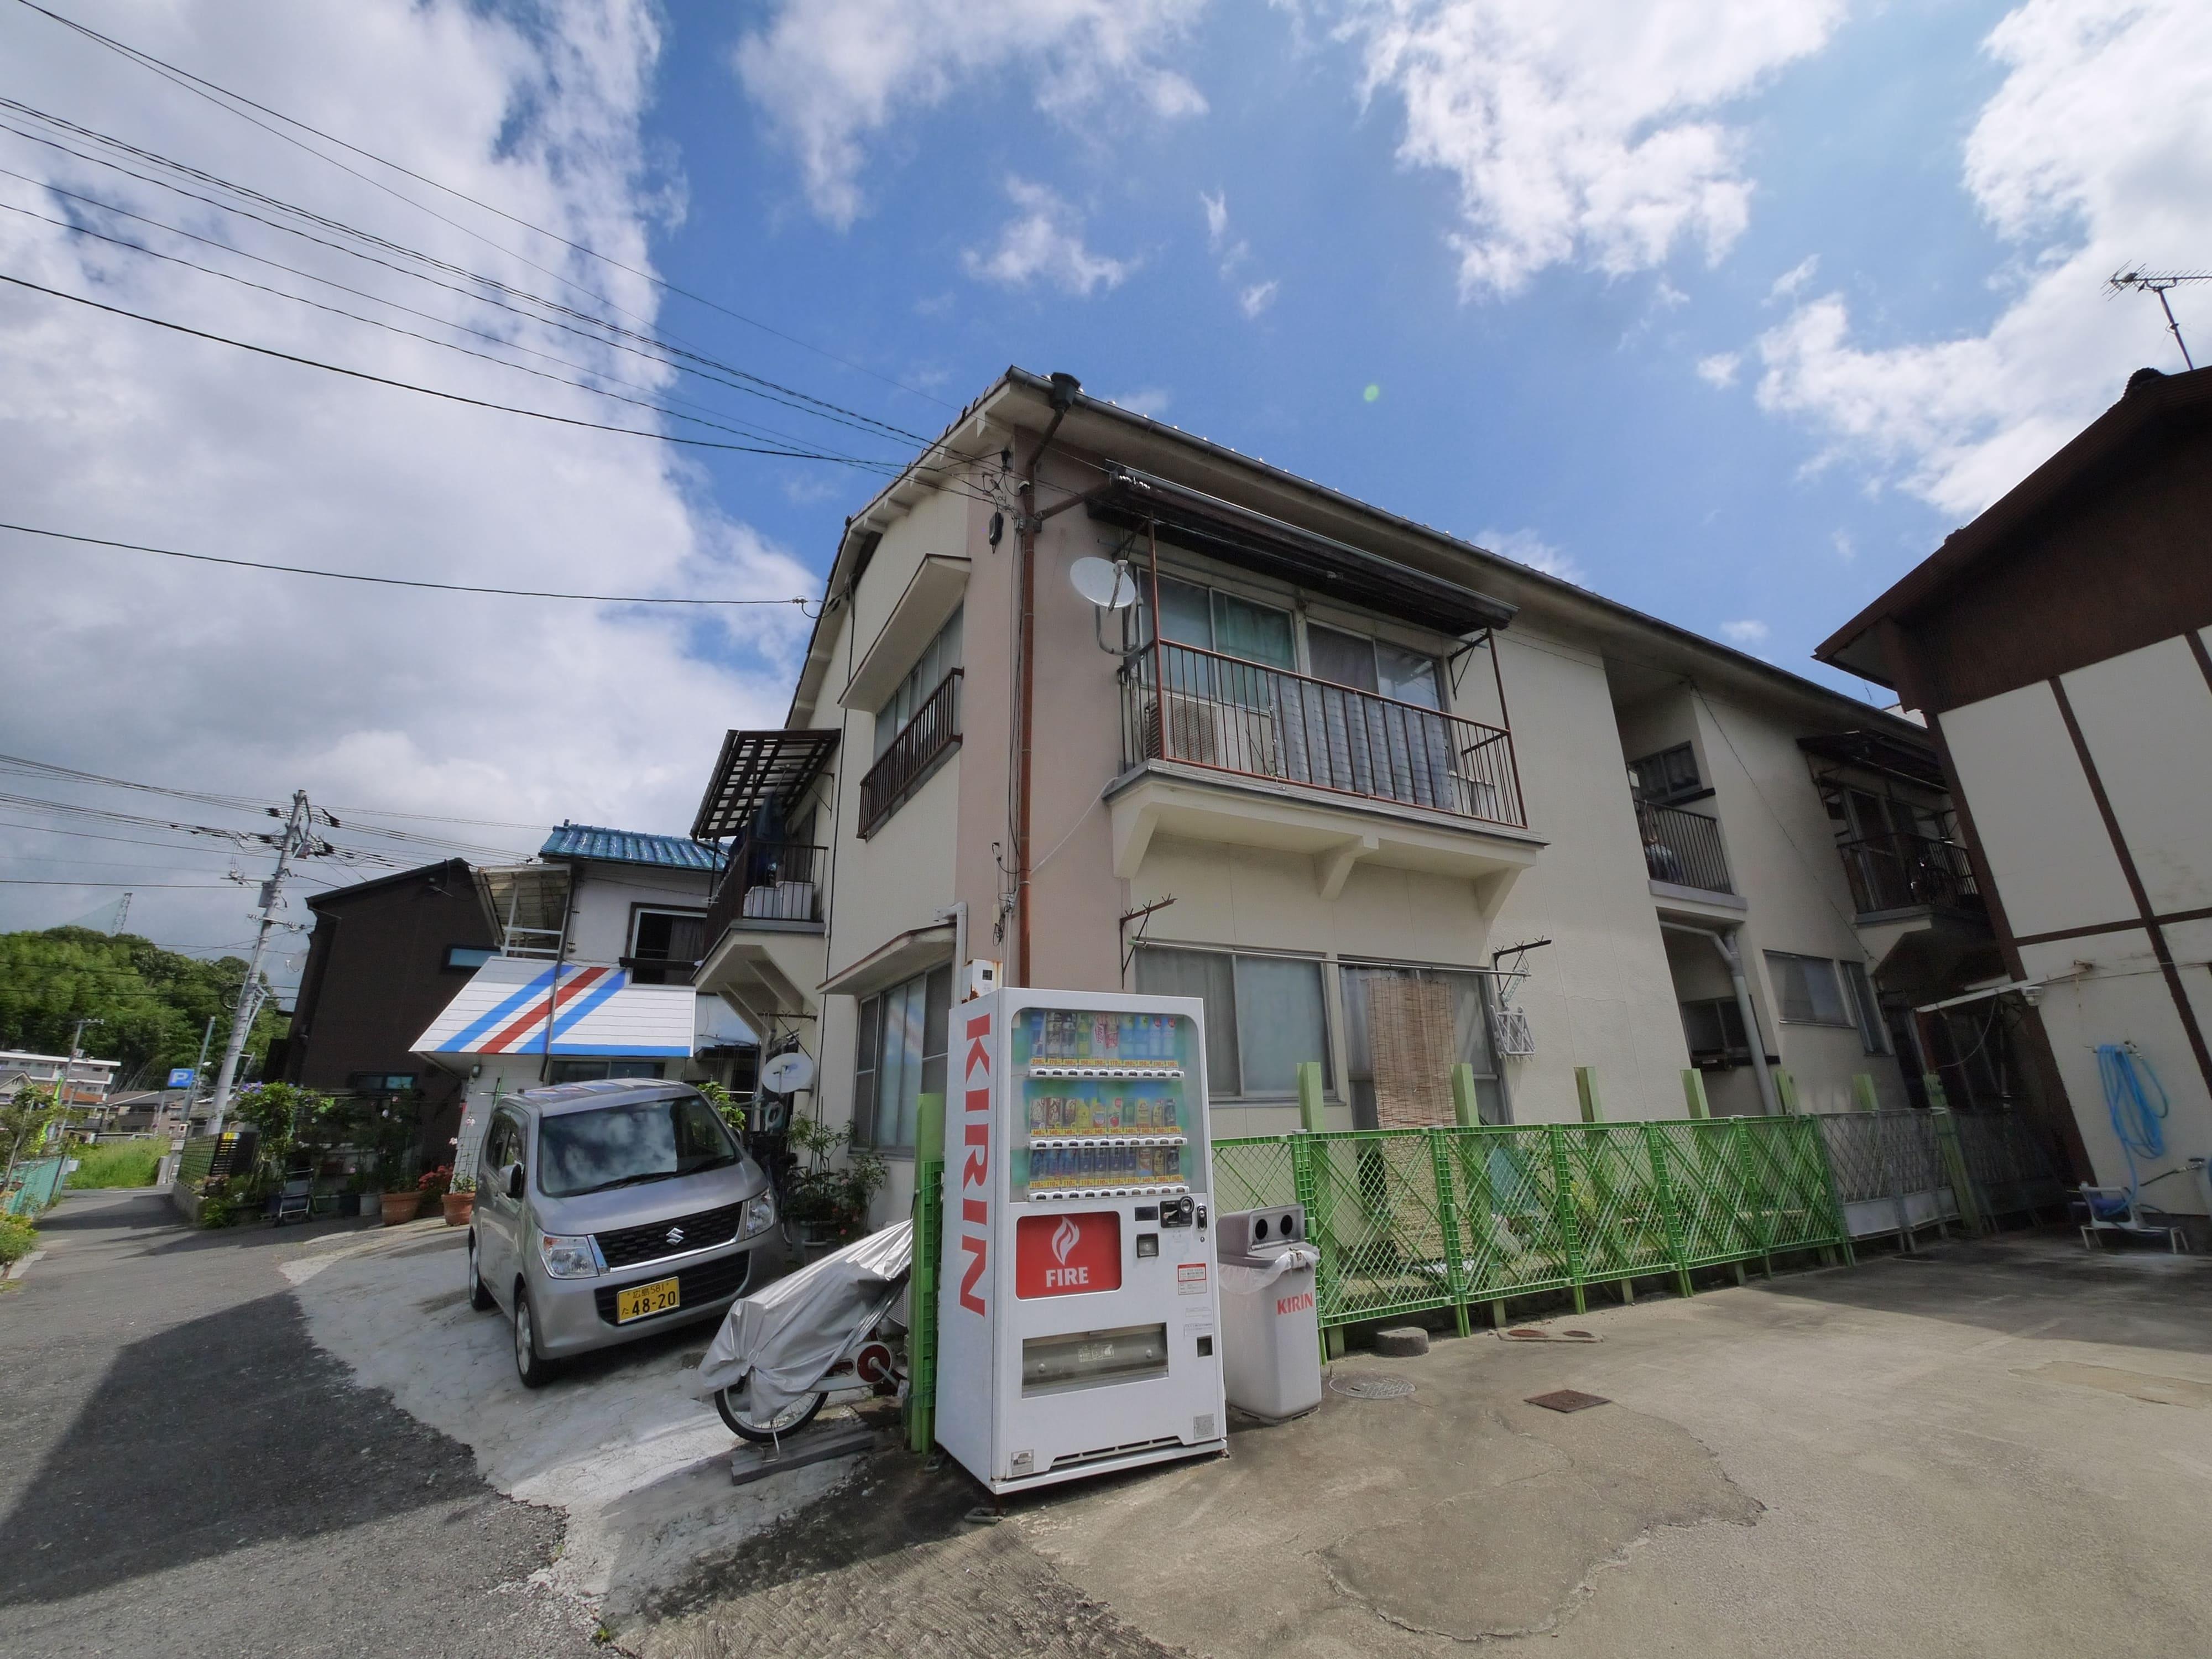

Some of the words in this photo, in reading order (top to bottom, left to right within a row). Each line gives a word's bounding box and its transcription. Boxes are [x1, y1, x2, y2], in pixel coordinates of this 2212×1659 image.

[172, 1072, 189, 1083] P
[959, 1013, 990, 1318] KIRIN
[1046, 1266, 1089, 1287] FIRE
[632, 1291, 676, 1316] 48-20
[1277, 1292, 1313, 1315] KIRIN
